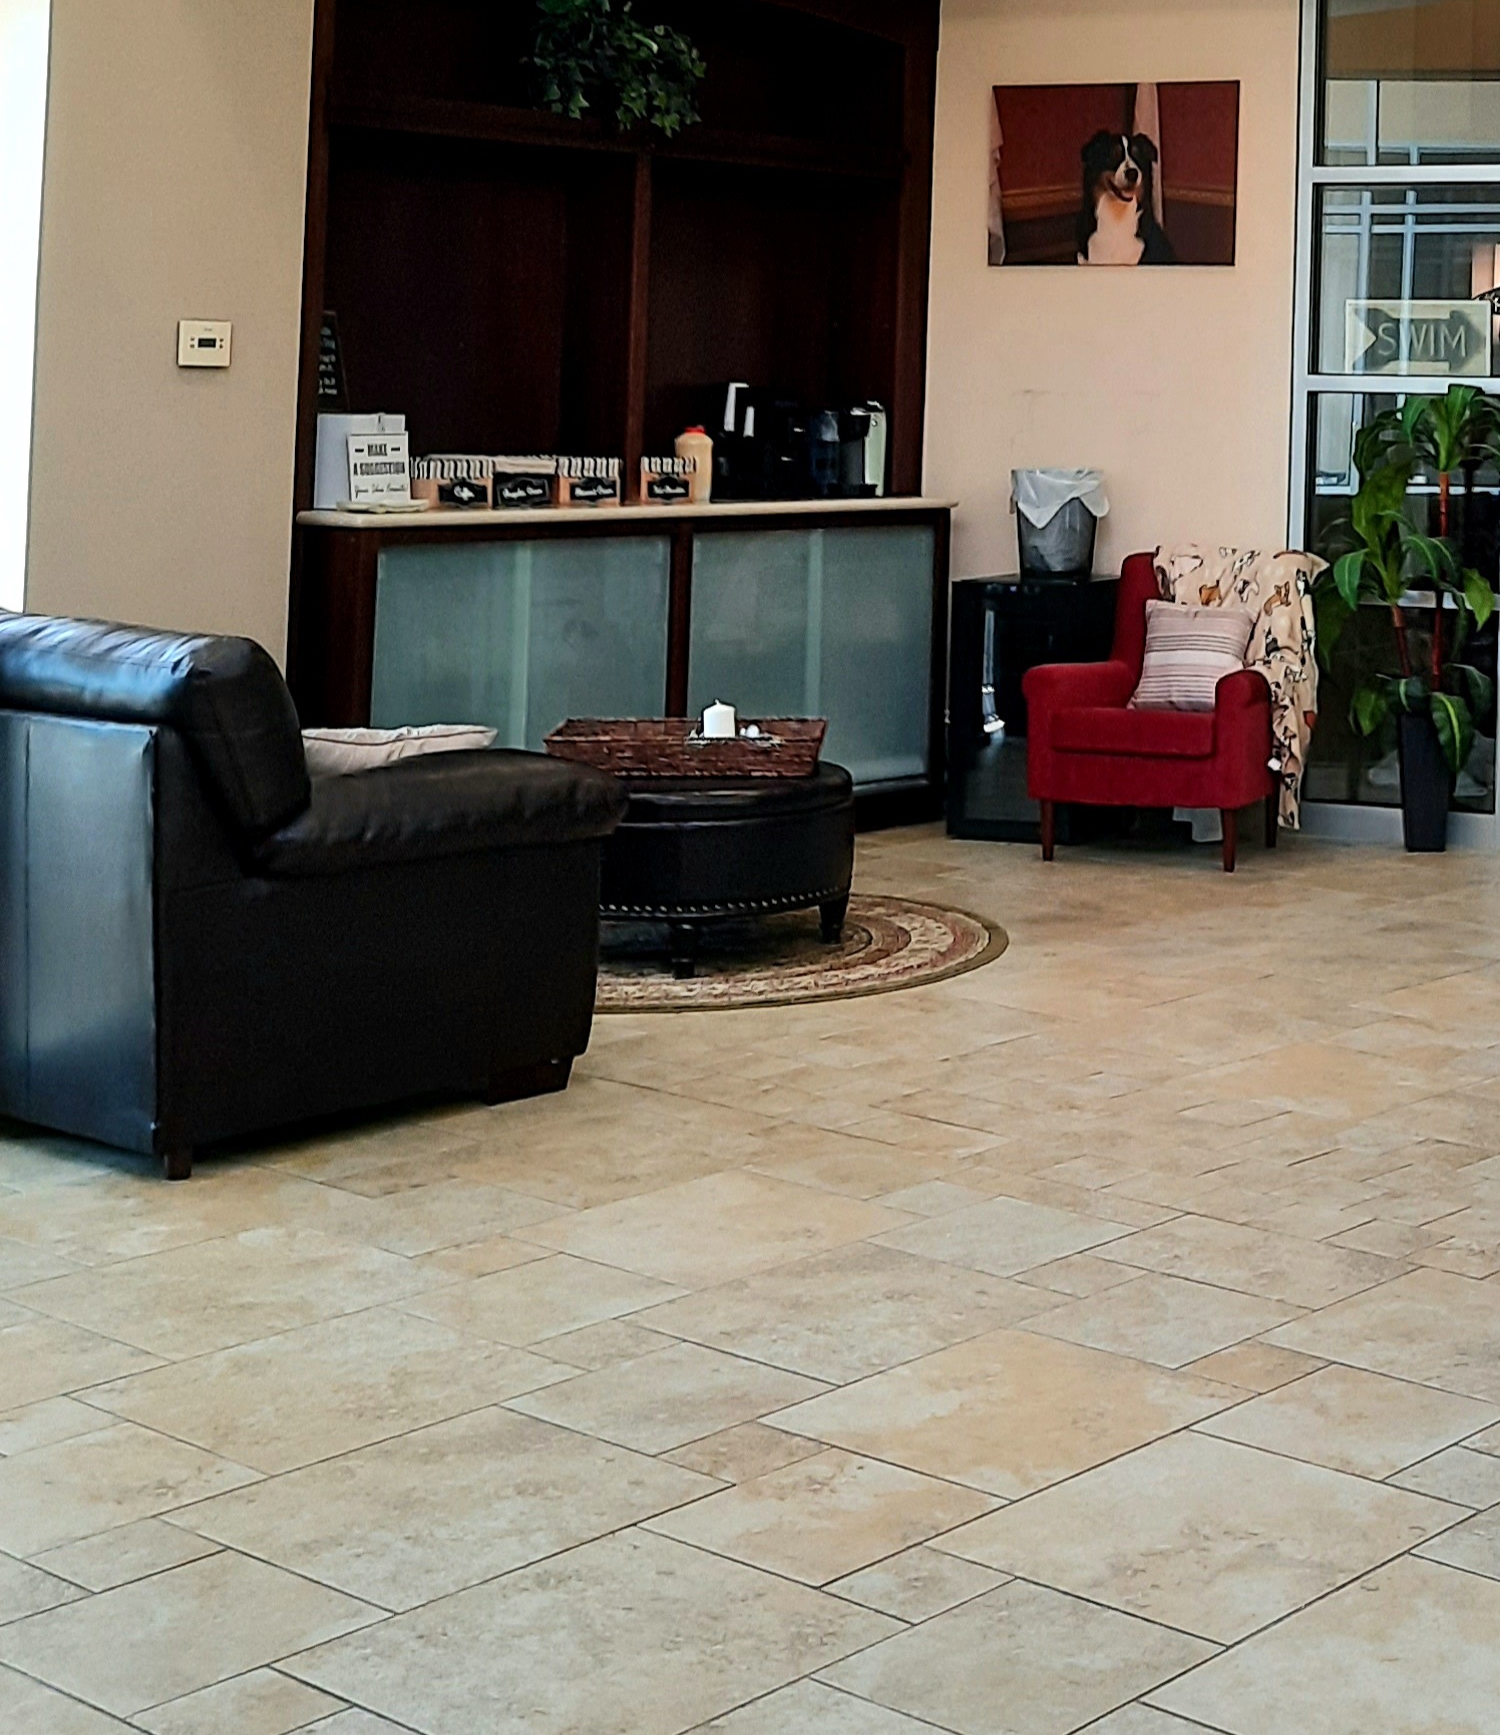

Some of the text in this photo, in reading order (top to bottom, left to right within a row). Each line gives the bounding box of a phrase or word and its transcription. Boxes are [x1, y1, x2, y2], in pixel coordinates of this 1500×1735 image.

[1377, 322, 1467, 358] SWIM
[367, 443, 388, 457] MAKE
[354, 463, 358, 475] A
